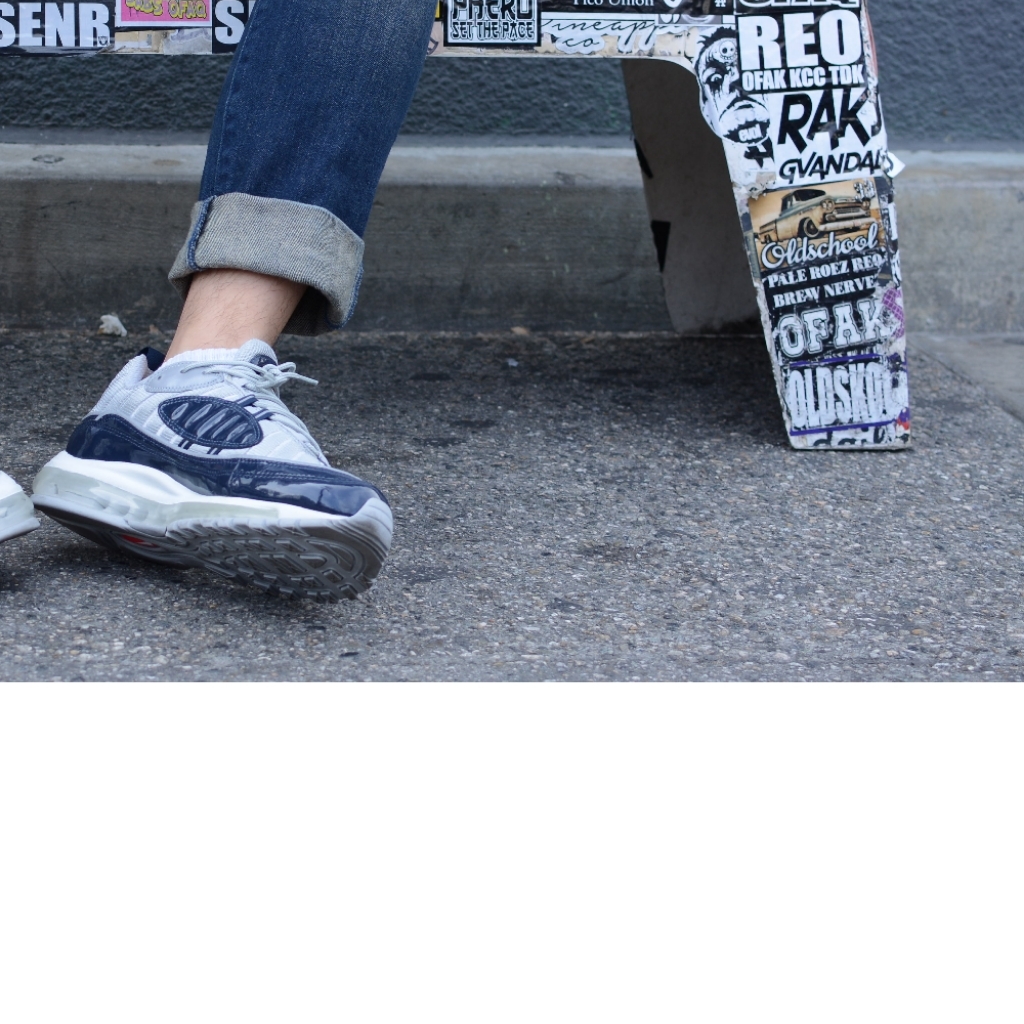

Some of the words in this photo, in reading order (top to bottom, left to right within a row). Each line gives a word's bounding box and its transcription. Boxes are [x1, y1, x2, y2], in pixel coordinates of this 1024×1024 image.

[452, 22, 472, 38] SET
[477, 22, 499, 39] THE
[503, 21, 534, 39] PACE
[737, 10, 863, 70] REO
[742, 69, 787, 92] OFAK
[789, 66, 827, 88] KCC
[828, 64, 865, 86] TDK
[761, 222, 879, 269] Oldschool
[767, 268, 807, 288] PALE
[809, 260, 850, 280] ROEZ
[773, 285, 821, 308] BREW
[824, 275, 877, 298] NERVE
